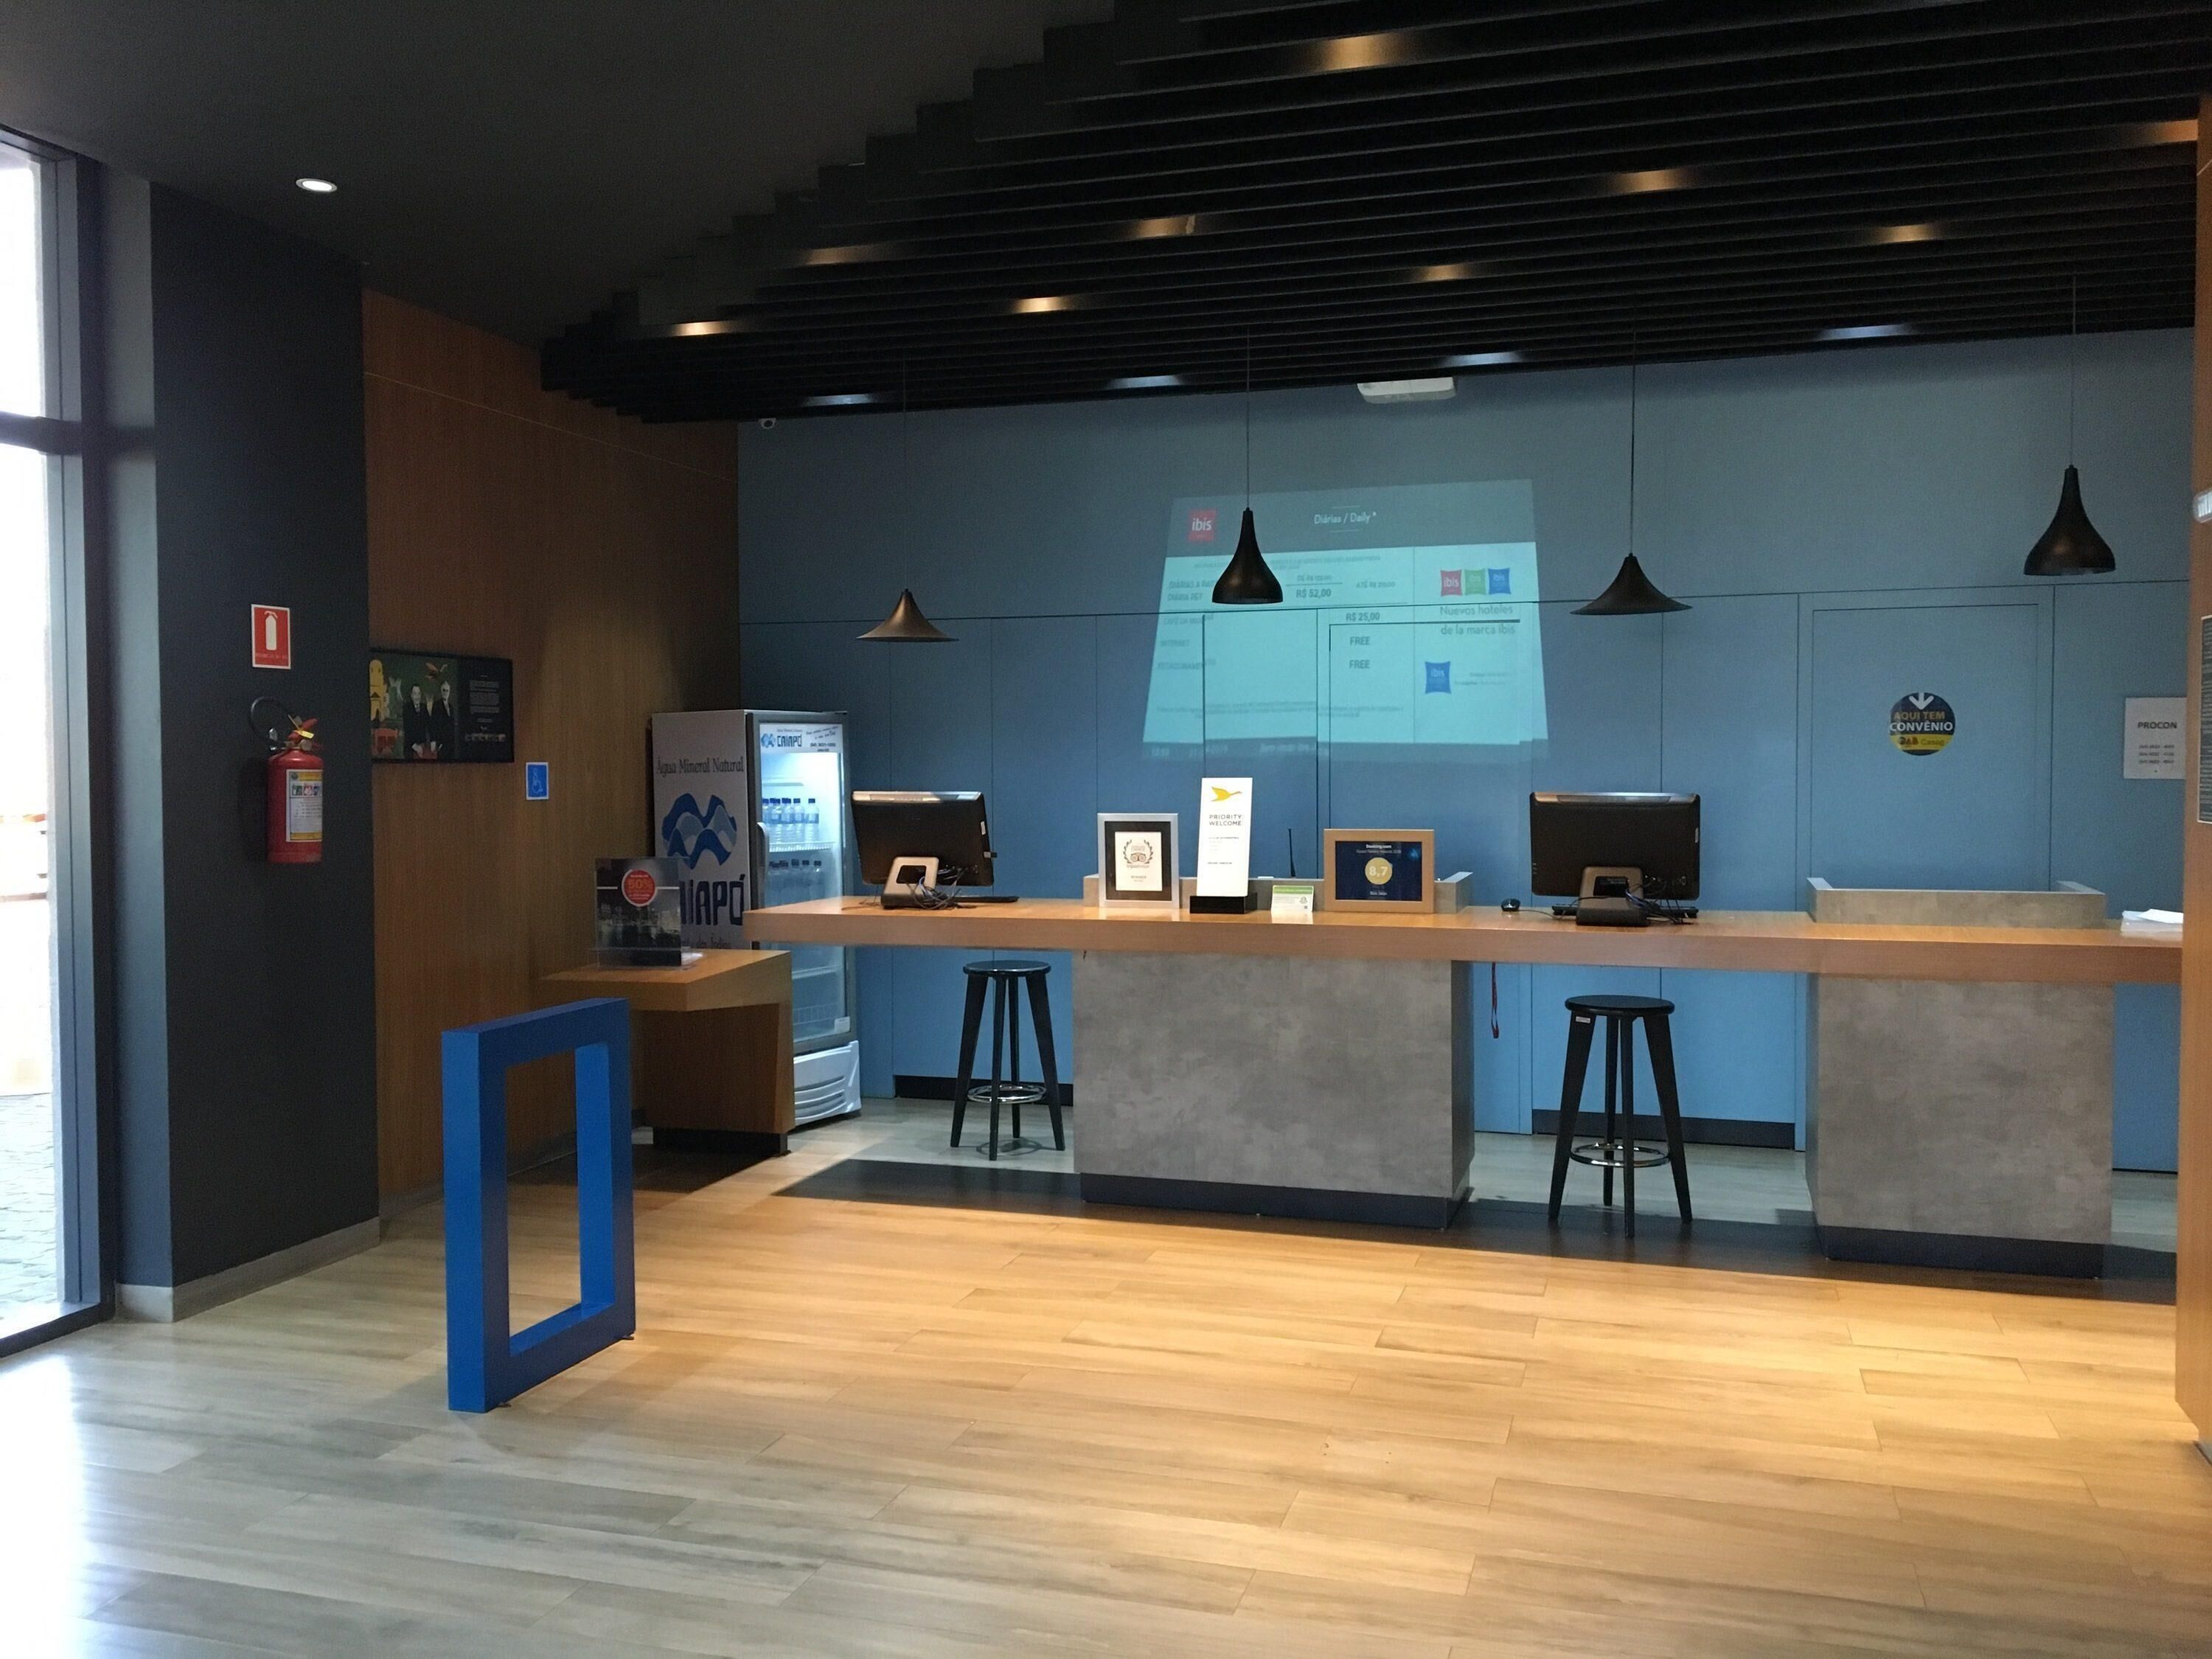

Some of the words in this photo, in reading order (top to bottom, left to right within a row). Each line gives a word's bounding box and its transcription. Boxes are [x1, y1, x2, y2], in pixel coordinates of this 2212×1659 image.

[1192, 518, 1212, 531] ibis
[1314, 514, 1342, 524] Diárias
[1444, 577, 1459, 587] ibis
[1296, 589, 1307, 599] R$
[1309, 588, 1332, 599] 52,00
[1440, 606, 1475, 616] Nuevos
[1478, 604, 1514, 614] hoteles
[1346, 613, 1357, 622] R$
[1358, 612, 1380, 622] 25,00
[1441, 625, 1453, 635] de
[1455, 624, 1464, 634] la
[1498, 624, 1516, 635] ibis
[1350, 636, 1371, 645] FREE
[1349, 660, 1370, 669] FREE
[1893, 712, 1921, 720] AQUI
[1922, 711, 1945, 720] TEM
[1890, 720, 1953, 731] CONVÊNIO
[656, 757, 676, 778] Água
[678, 757, 710, 773] Mineral
[712, 756, 744, 772] Natural
[1369, 866, 1388, 877] 8,7
